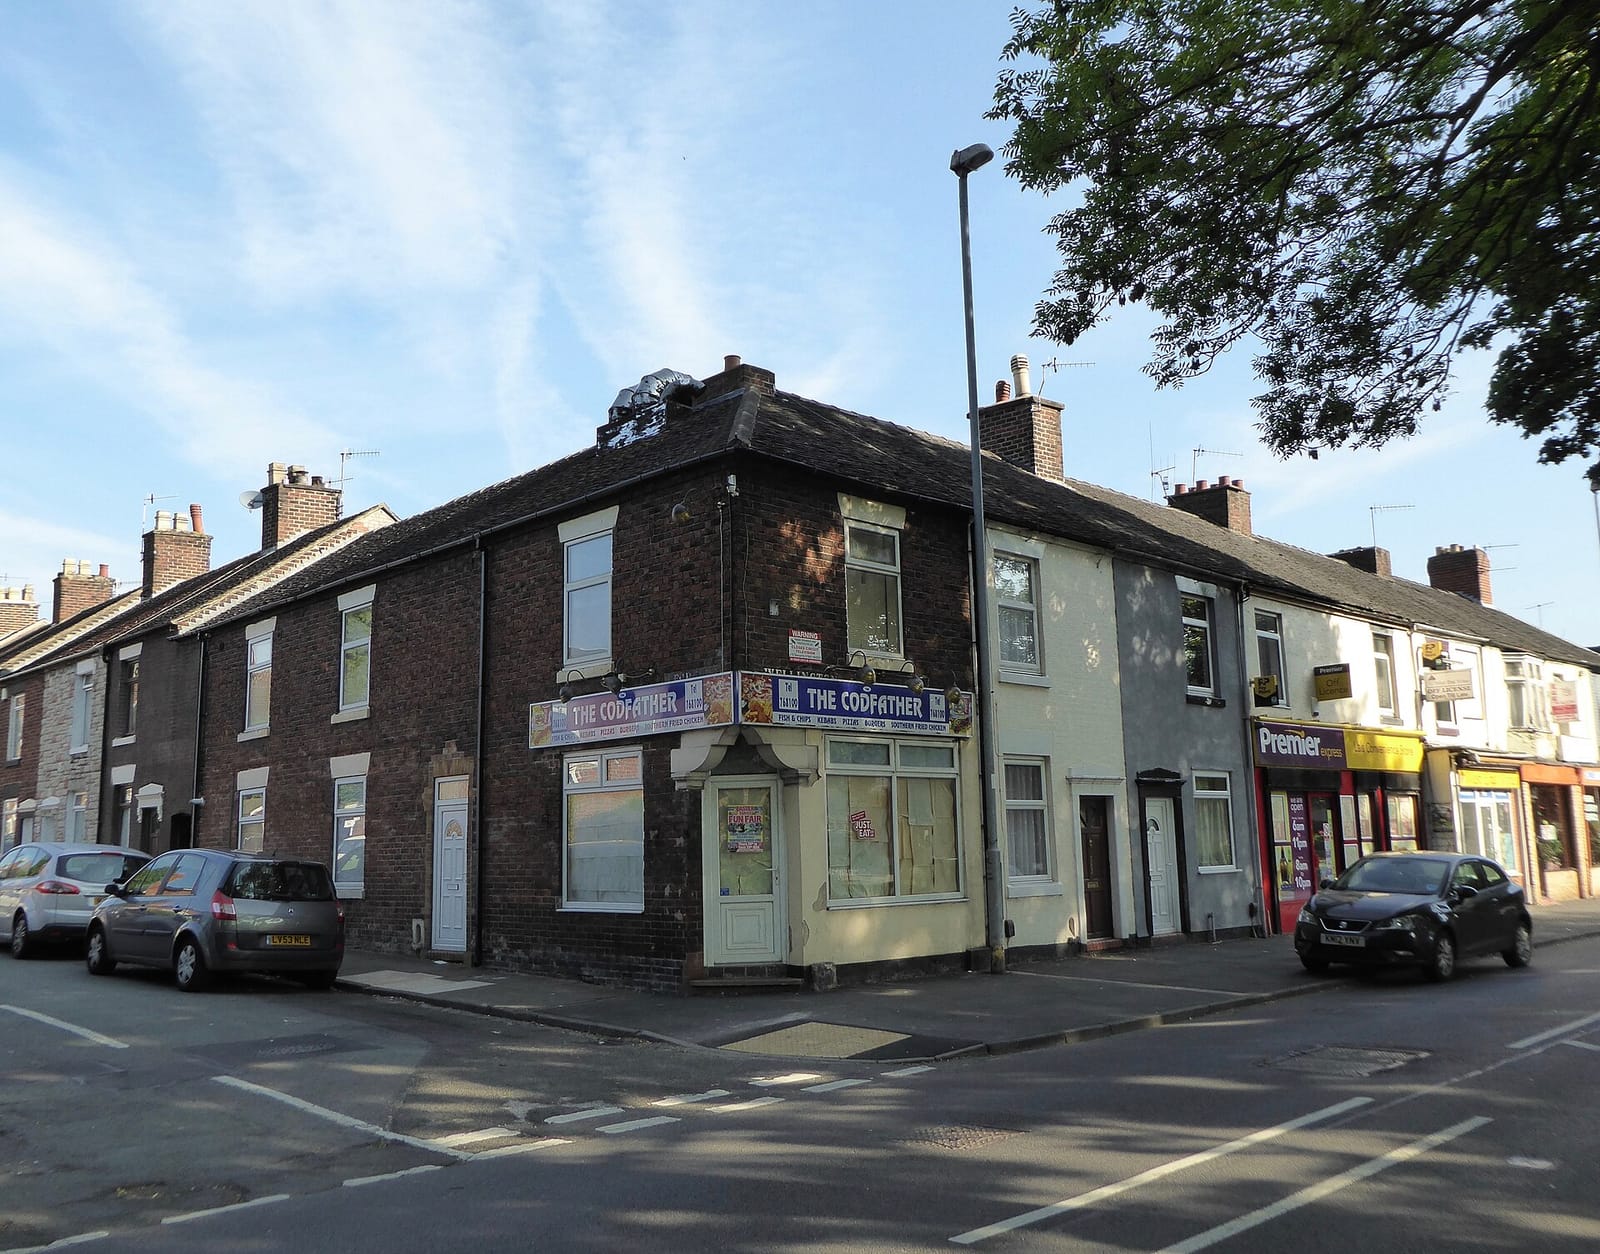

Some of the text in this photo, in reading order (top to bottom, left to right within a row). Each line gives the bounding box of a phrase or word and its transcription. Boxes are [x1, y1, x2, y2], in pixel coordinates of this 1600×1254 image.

[792, 629, 818, 639] WARNING
[1319, 666, 1343, 674] Premier
[572, 704, 597, 726] THE
[600, 691, 679, 723] CODFATHER
[806, 687, 924, 719] THE CODFATHER
[669, 718, 683, 728] FRIED
[683, 715, 704, 726] CHICKEN
[817, 717, 837, 725] KEBABS
[864, 720, 886, 728] BURGERS
[890, 721, 915, 730] SOUTHERN
[915, 722, 928, 730] FRIED
[928, 723, 947, 732] CHICKEN
[1259, 726, 1343, 760] Premier express
[1290, 804, 1304, 813] open
[728, 815, 762, 823] FUN FAIR
[855, 821, 871, 829] JUST
[1292, 819, 1305, 831] 6am
[1292, 837, 1308, 851] 11pm
[1295, 859, 1309, 871] 8am
[1295, 876, 1312, 890] 10pm
[271, 935, 293, 944] LV53
